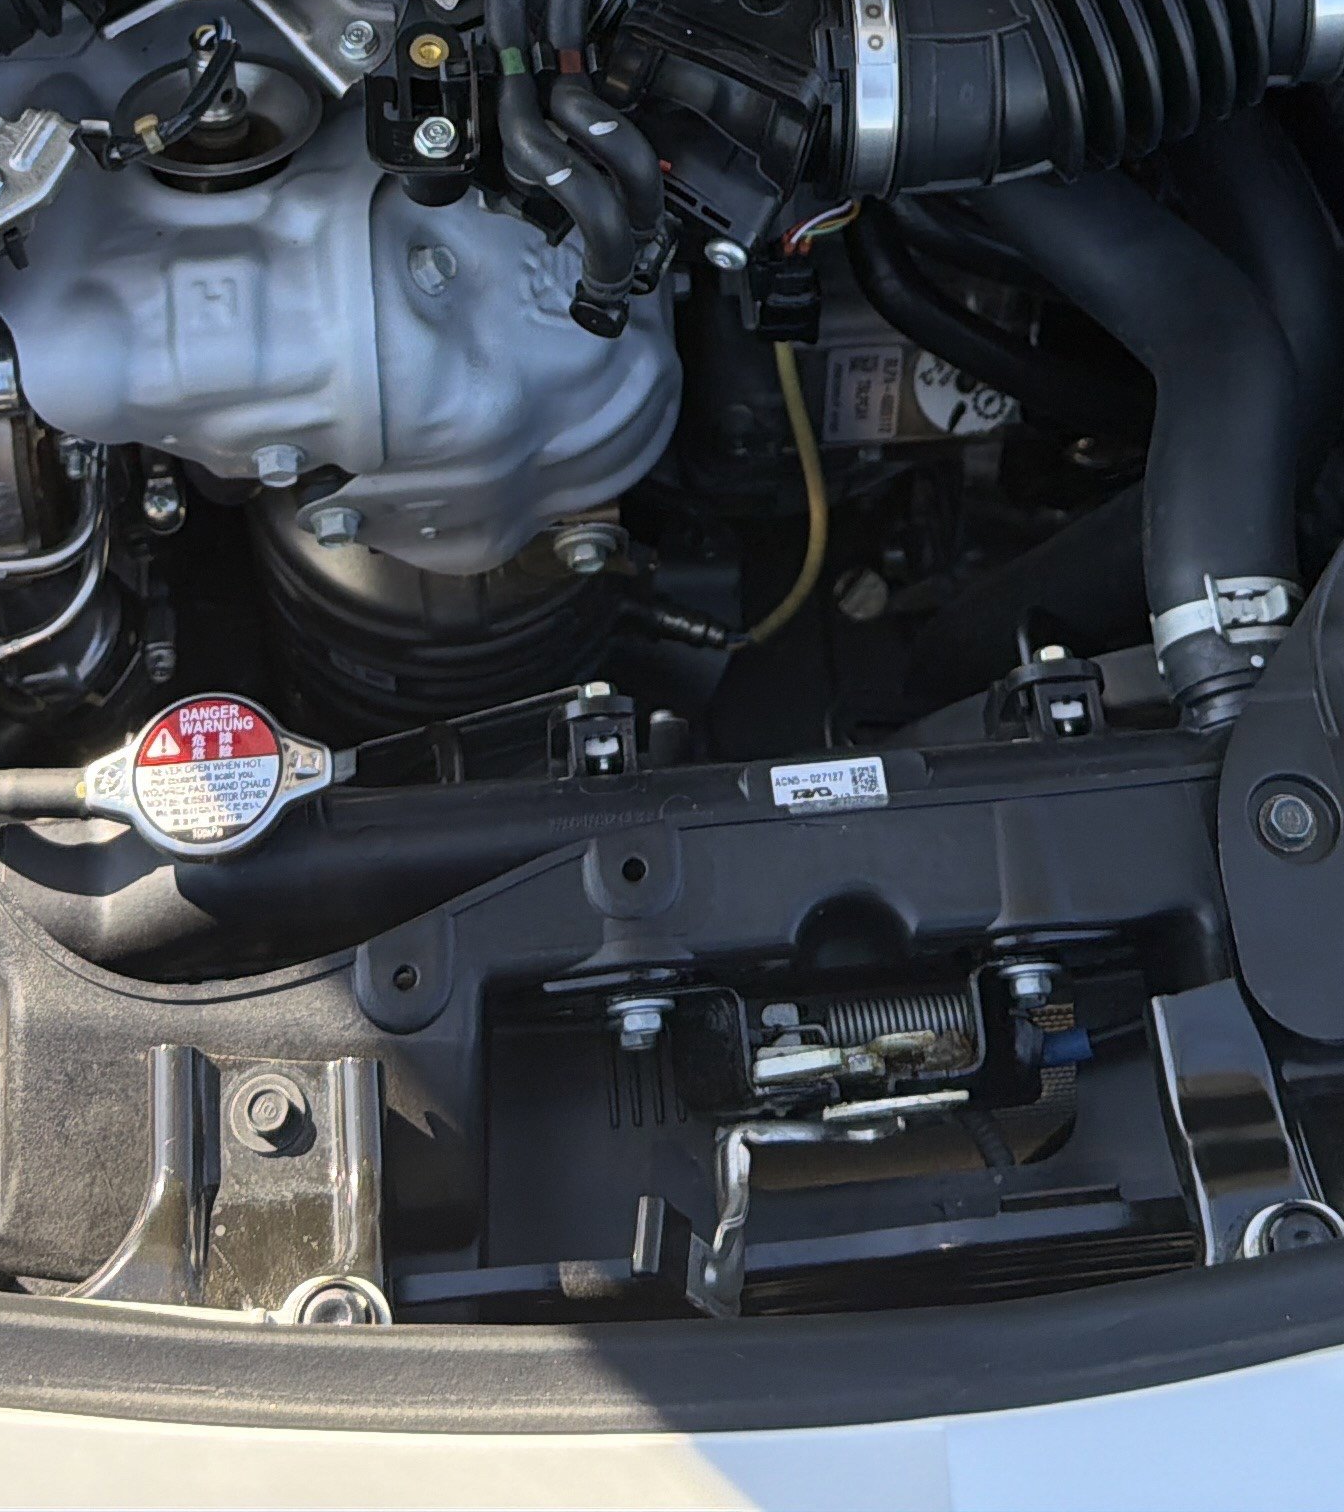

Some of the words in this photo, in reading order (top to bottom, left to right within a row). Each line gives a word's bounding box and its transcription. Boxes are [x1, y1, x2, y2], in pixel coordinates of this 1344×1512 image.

[179, 704, 240, 722] DANGER
[179, 716, 254, 736] WARNUNG
[185, 763, 211, 773] OPEN
[213, 760, 241, 771] WHEN
[214, 769, 236, 780] scald
[188, 784, 205, 794] PAS
[208, 781, 238, 792] QUAND
